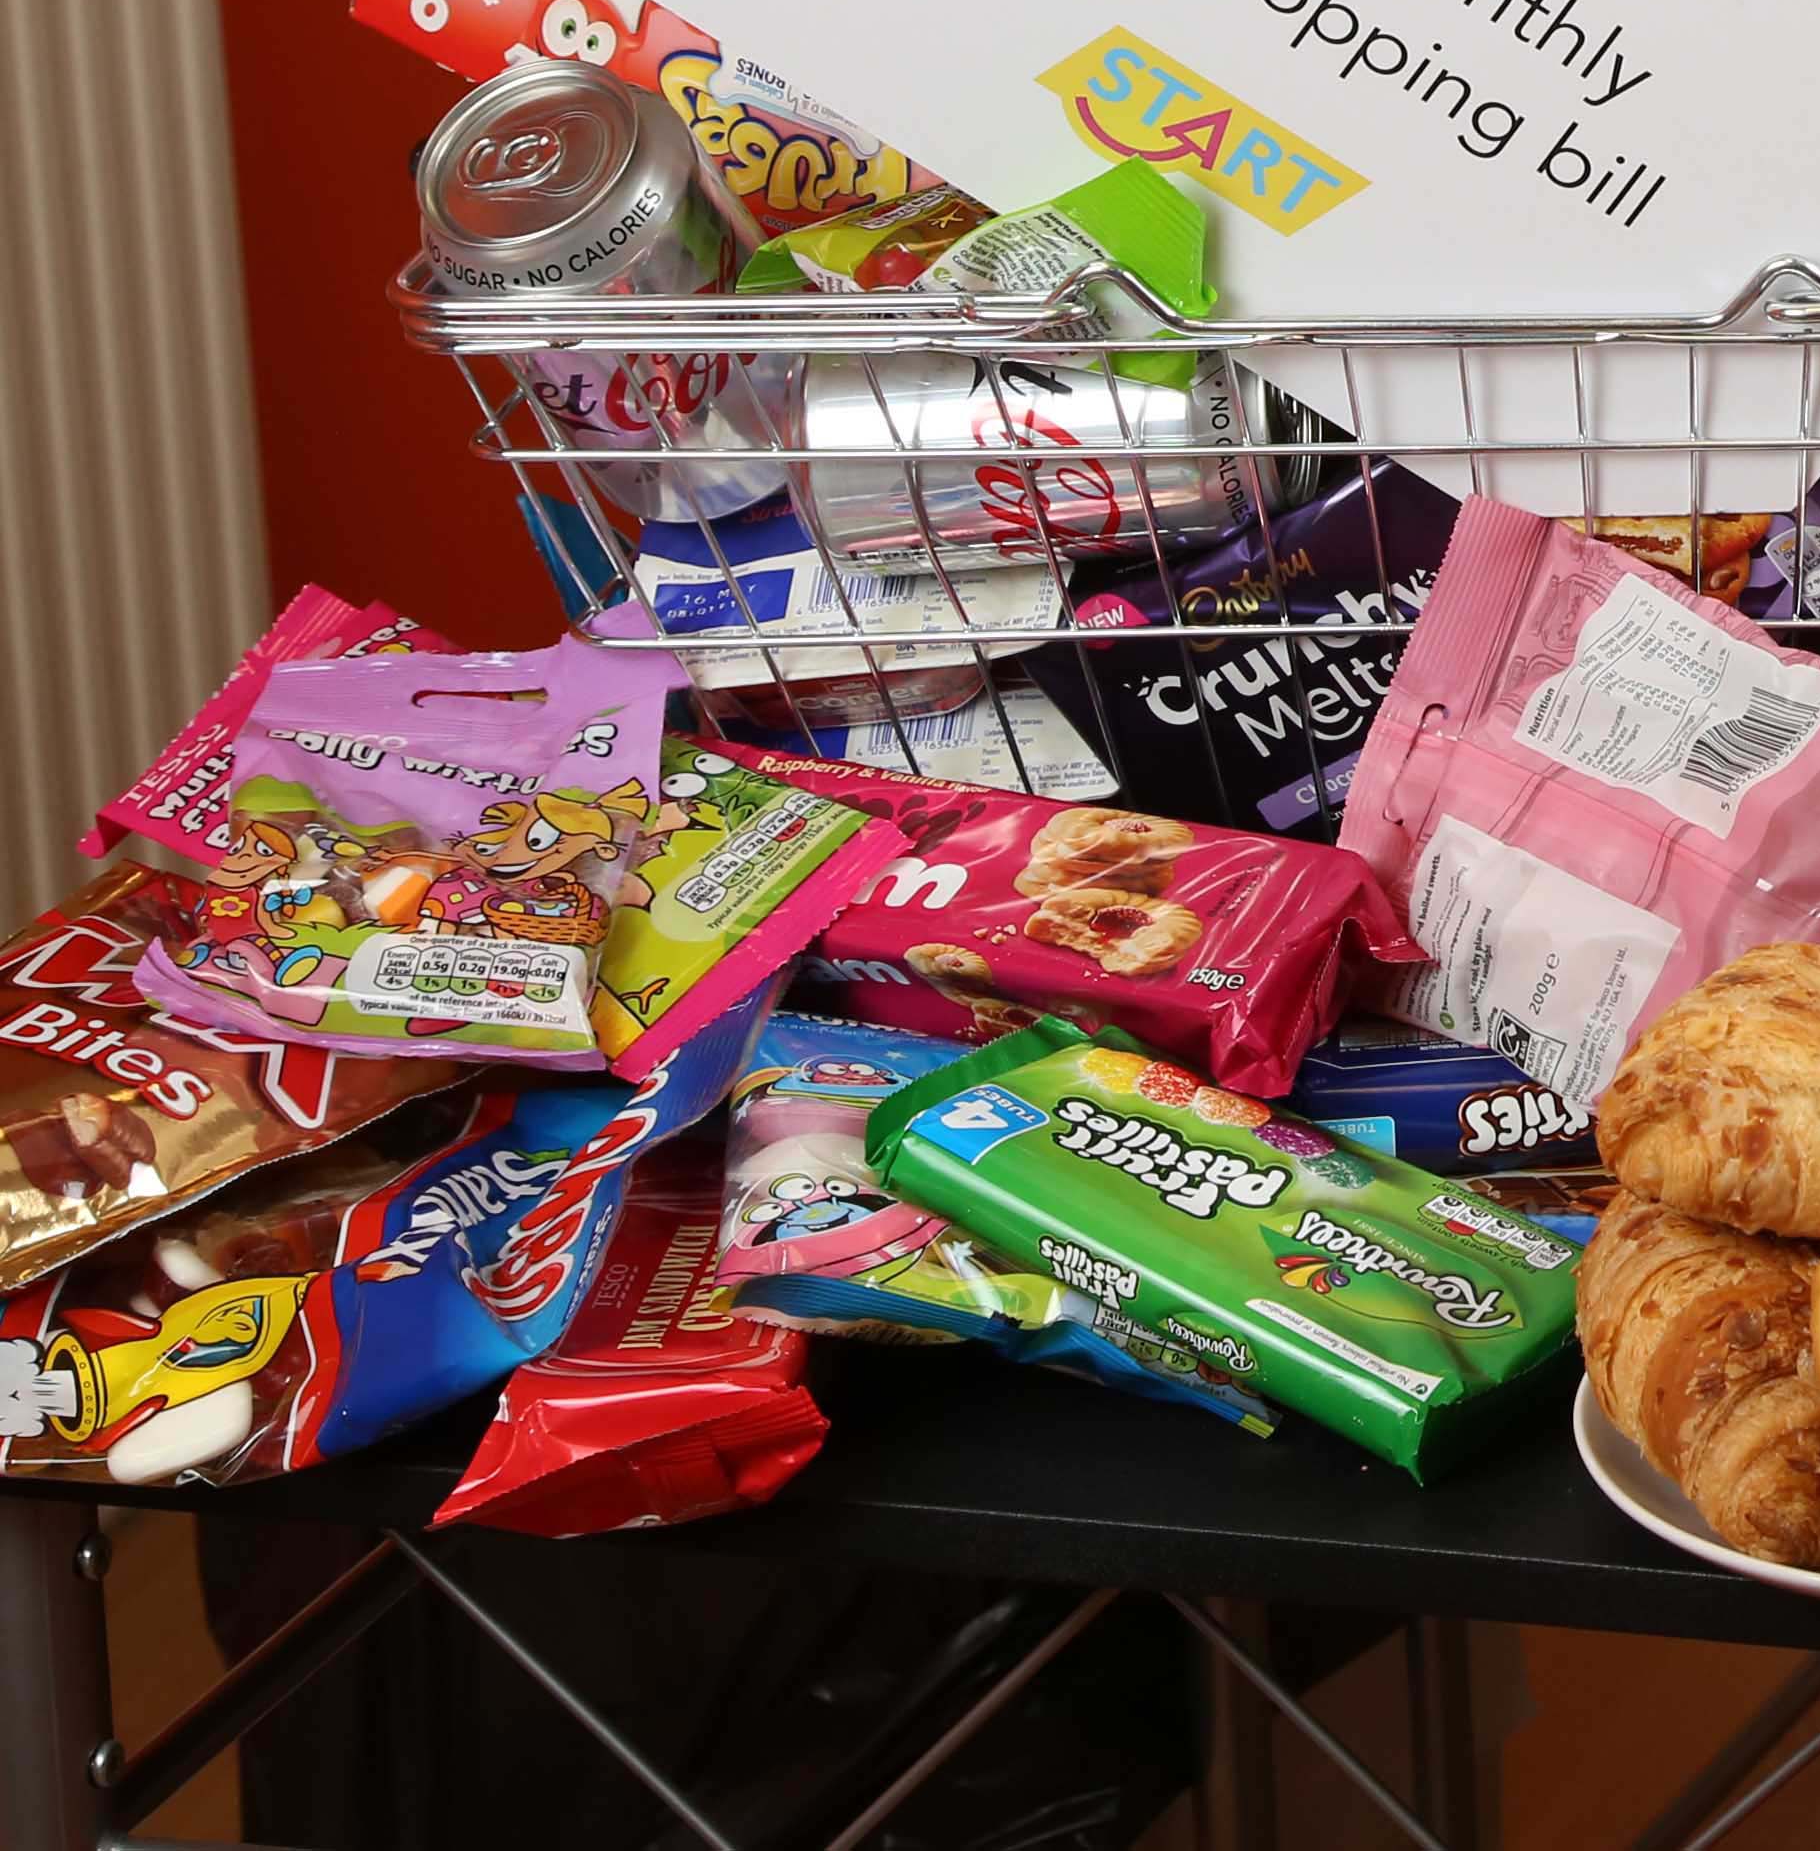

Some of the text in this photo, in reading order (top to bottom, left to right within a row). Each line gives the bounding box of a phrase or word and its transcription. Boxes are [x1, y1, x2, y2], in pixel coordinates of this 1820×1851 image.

[1086, 47, 1342, 216] START
[1537, 120, 1667, 229] bill
[424, 186, 662, 291] NO SUGAR NO CALORIES
[532, 373, 598, 417] et
[1208, 395, 1232, 429] NO
[716, 582, 758, 601] MY
[1526, 687, 1555, 739] Nutrition
[119, 724, 231, 812] TESCO
[268, 729, 385, 769] olly
[757, 755, 859, 785] Raspberry
[858, 765, 875, 780] &
[422, 960, 449, 974] 0.5g
[458, 962, 487, 976] 0.2g
[494, 965, 527, 979] 19.0g
[805, 957, 911, 988] am
[359, 999, 390, 1012] Typical
[1528, 971, 1557, 1016] 200g
[0, 1002, 214, 1118] Bites
[939, 1099, 1009, 1129] 4
[971, 1087, 1037, 1124] TUBES
[1055, 1099, 1288, 1208] Pastilles
[1056, 1126, 1219, 1218] Fruit
[594, 1262, 631, 1310] TESCO
[617, 1223, 717, 1351] JAM SANDWICH
[1038, 1236, 1138, 1301] Pastilles
[1050, 1263, 1121, 1309] Fruit
